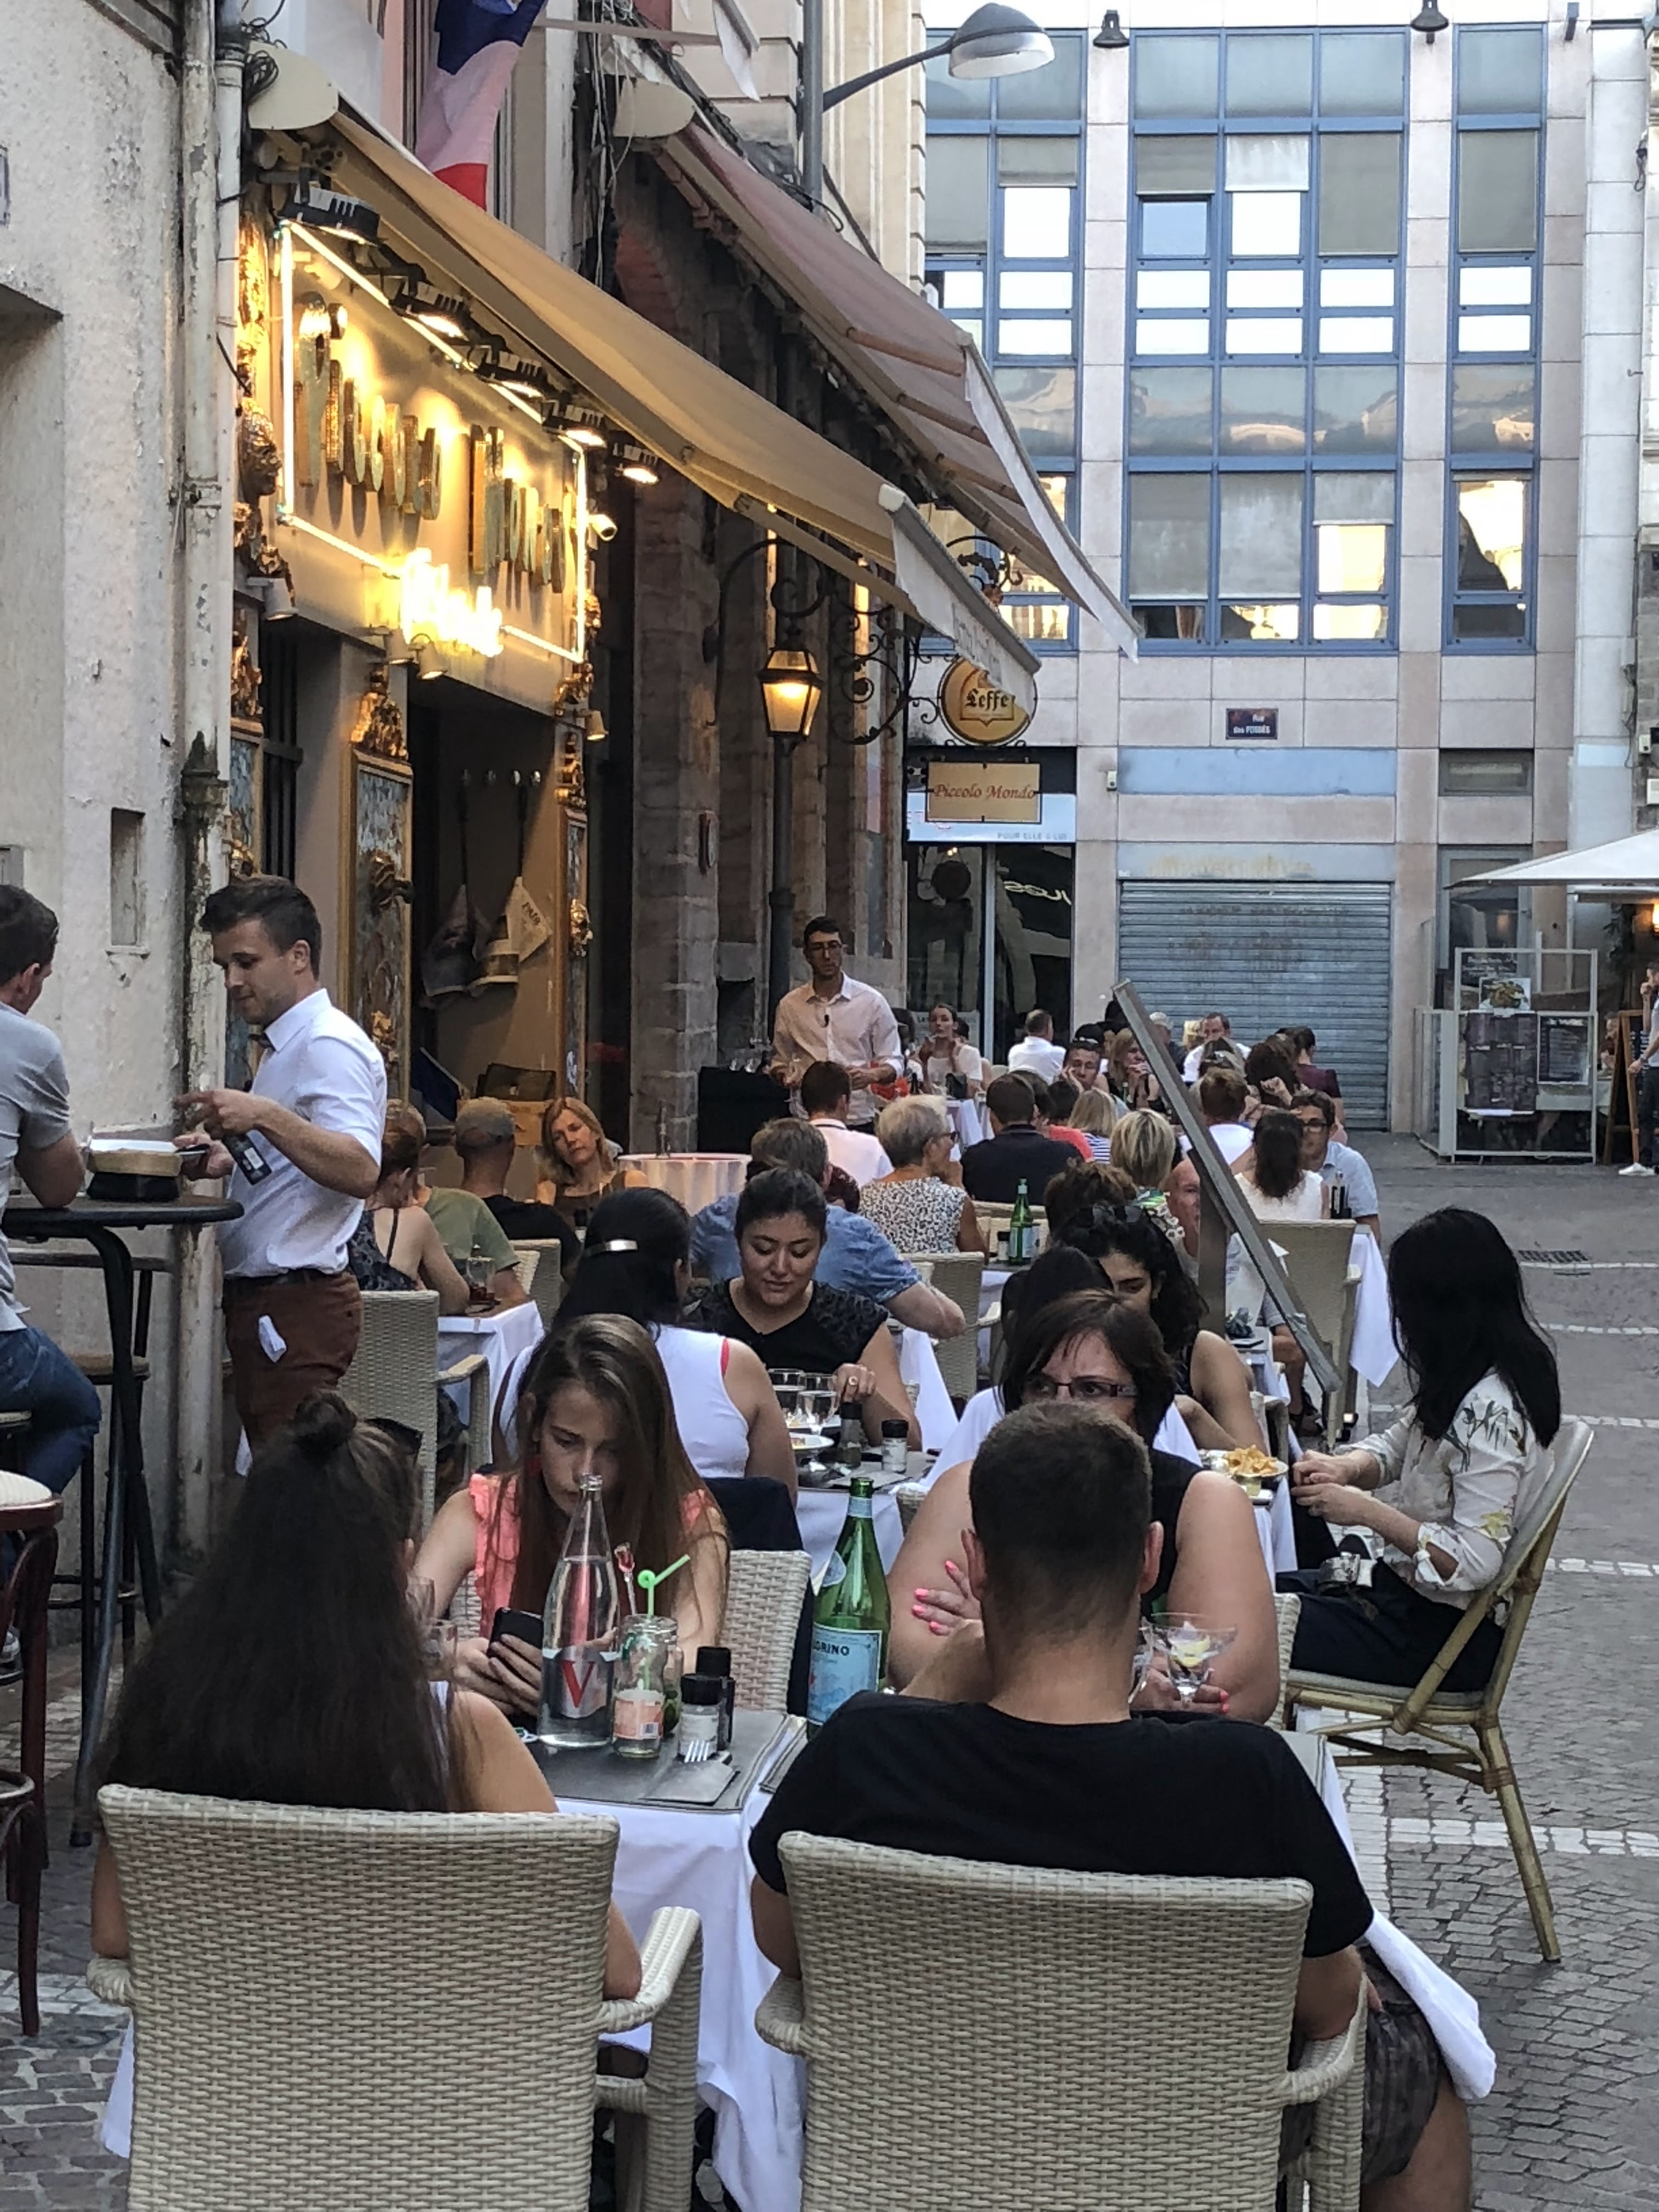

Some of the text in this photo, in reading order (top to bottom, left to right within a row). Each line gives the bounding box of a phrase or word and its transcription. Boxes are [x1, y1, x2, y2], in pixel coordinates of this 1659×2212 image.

[965, 687, 1009, 712] Leffe
[933, 783, 1035, 799] Piccolo Mondo
[561, 1660, 595, 1708] V
